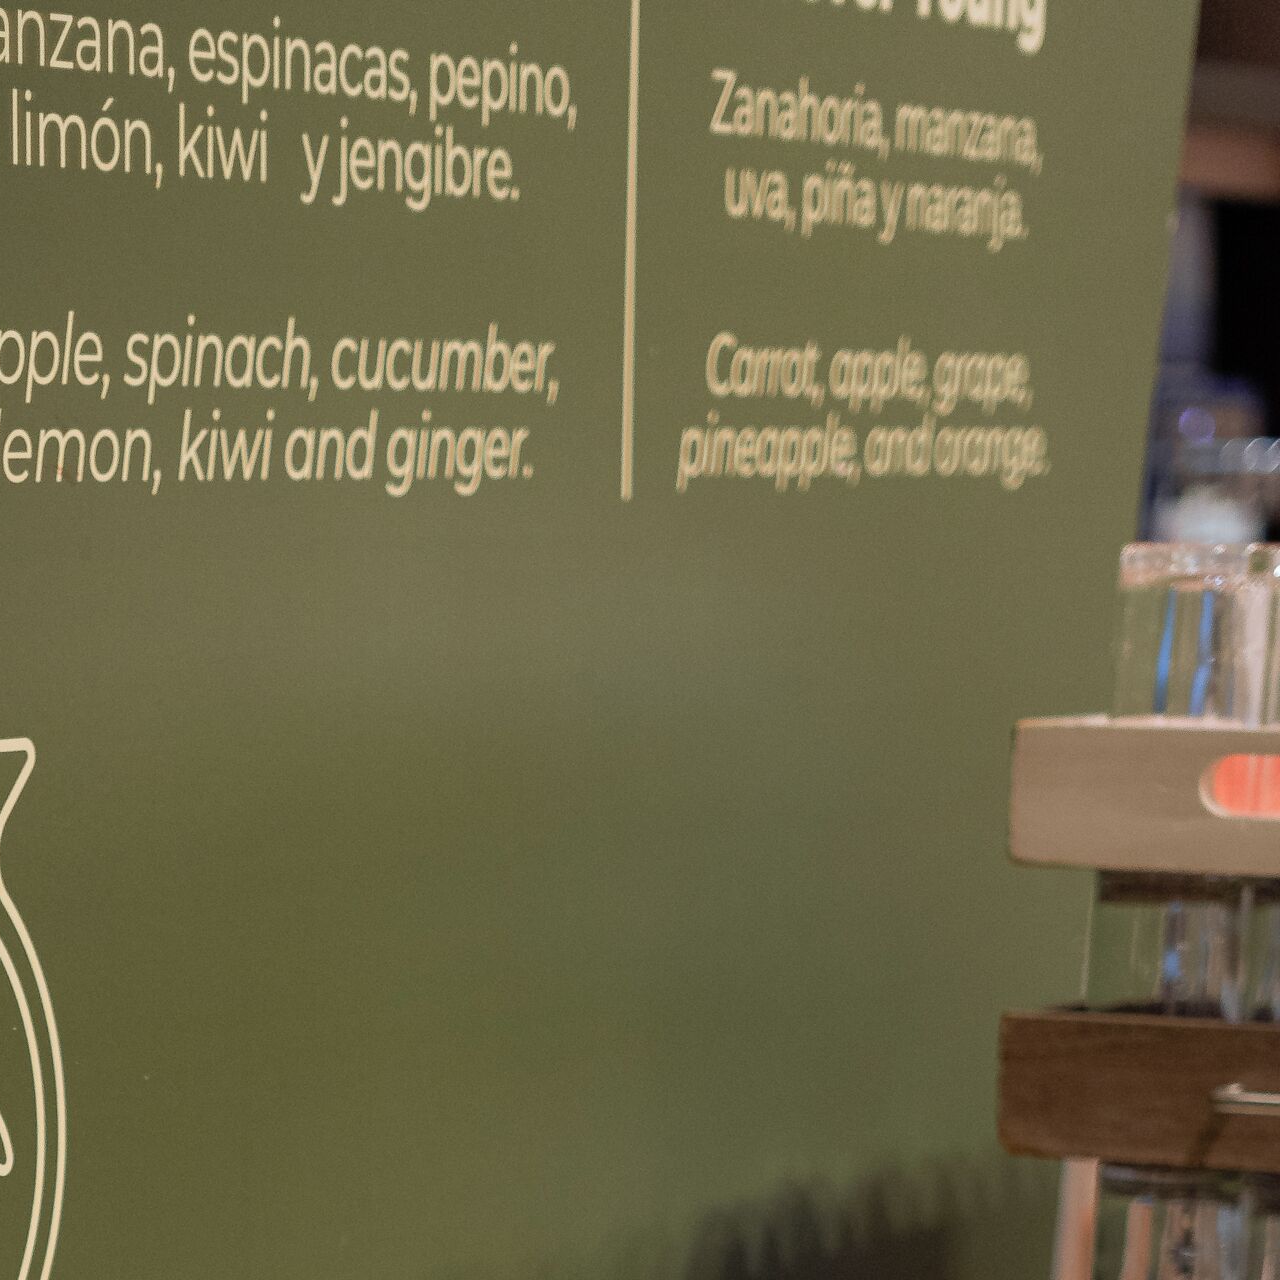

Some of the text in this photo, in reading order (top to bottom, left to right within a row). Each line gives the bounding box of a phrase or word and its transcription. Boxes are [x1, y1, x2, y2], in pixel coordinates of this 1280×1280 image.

[189, 16, 418, 118] espinacas,
[429, 41, 577, 132] pepino,
[710, 68, 890, 160] Zanahoria,
[12, 87, 520, 213] limón, kiwi y jengibre.
[724, 168, 796, 231] uva,
[801, 160, 877, 236] piña
[878, 182, 904, 244] y
[124, 314, 319, 405] spinach,
[331, 322, 559, 404] cucumber,
[706, 331, 825, 407] Carrot,
[178, 408, 275, 481] kiwi
[285, 409, 379, 481] and
[385, 409, 533, 497] ginger.
[864, 415, 935, 477] and
